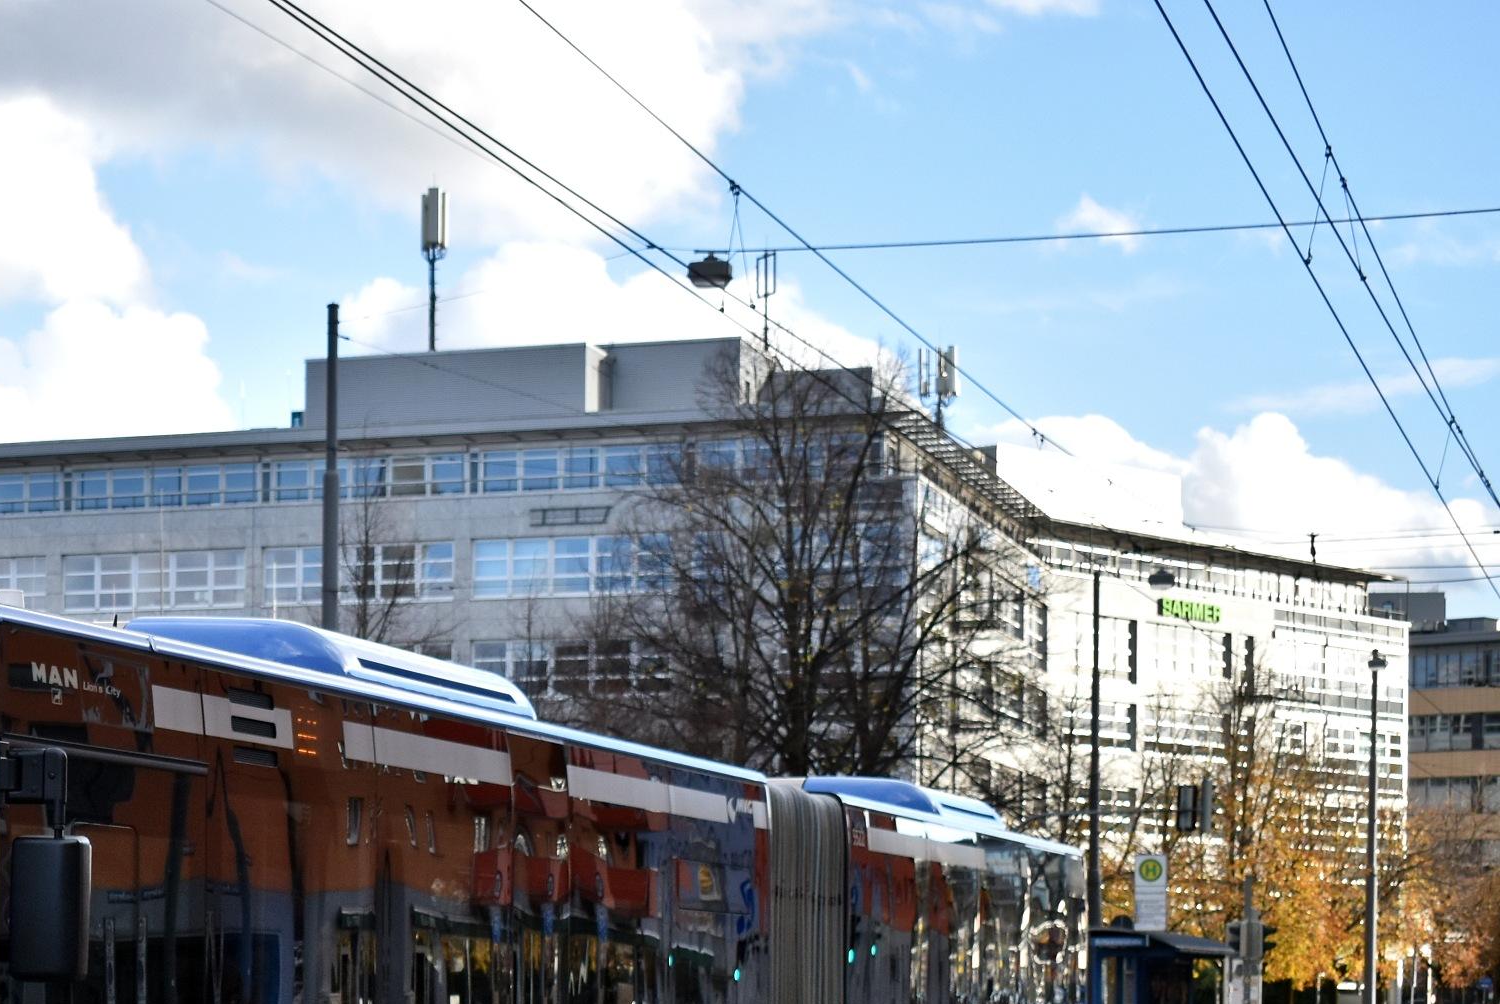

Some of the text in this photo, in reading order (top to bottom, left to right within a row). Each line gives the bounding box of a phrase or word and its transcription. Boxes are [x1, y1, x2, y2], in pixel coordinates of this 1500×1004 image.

[1160, 597, 1222, 624] BARMER
[30, 661, 79, 690] MAN
[105, 685, 121, 699] City
